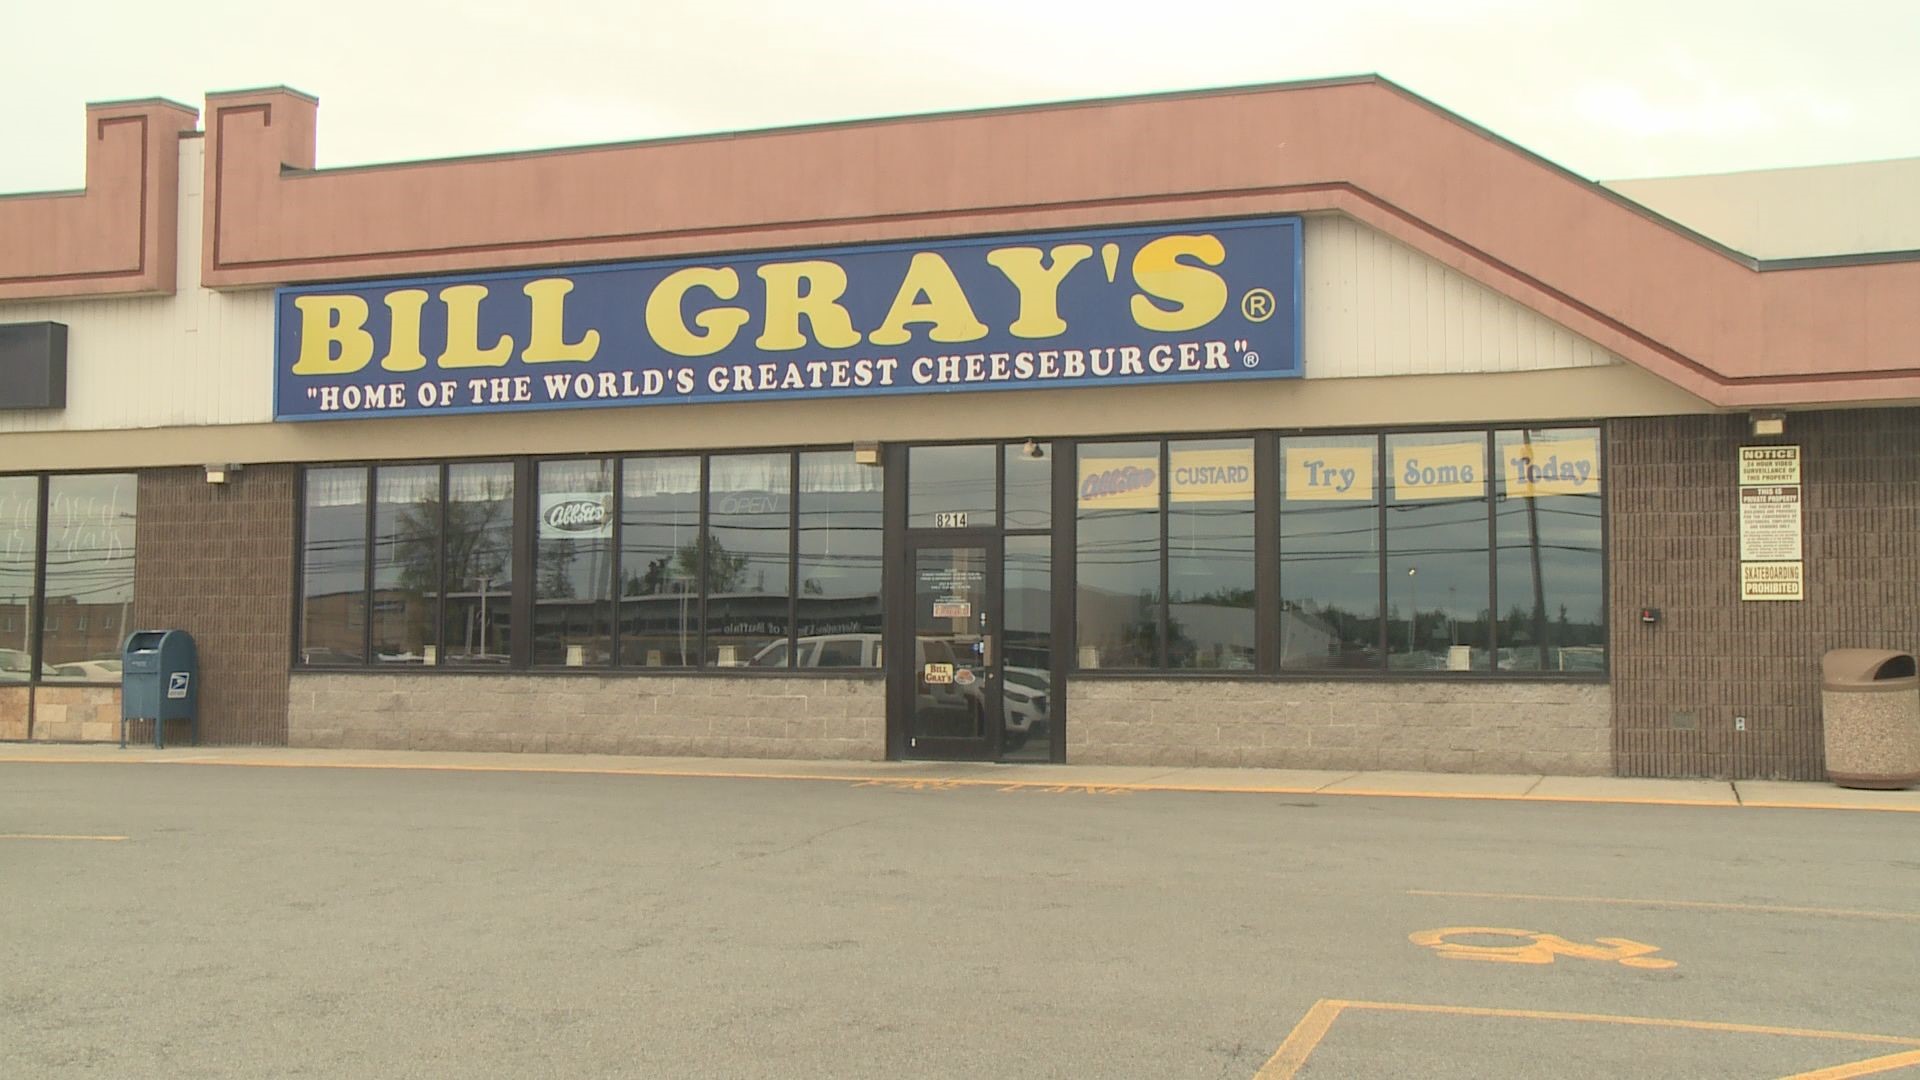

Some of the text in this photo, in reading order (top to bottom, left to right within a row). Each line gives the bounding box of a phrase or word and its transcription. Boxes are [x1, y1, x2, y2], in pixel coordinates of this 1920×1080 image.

[292, 278, 600, 375] BILL
[645, 234, 1228, 357] GRAY'S
[307, 382, 406, 411] "HOME
[418, 381, 458, 408] OF
[469, 376, 531, 405] THE
[544, 367, 695, 400] WORLD'S
[708, 358, 898, 394] GREATEST
[1744, 450, 1795, 459] NOTICE
[1175, 465, 1249, 487] CUSTARD
[1303, 460, 1355, 493] Try
[1404, 458, 1474, 486] Some
[1510, 455, 1591, 487] Today
[720, 494, 778, 513] OPEN
[937, 513, 966, 527] 8214
[1744, 566, 1799, 579] SKATEBOARDING
[1746, 582, 1798, 593] PROHIBITED
